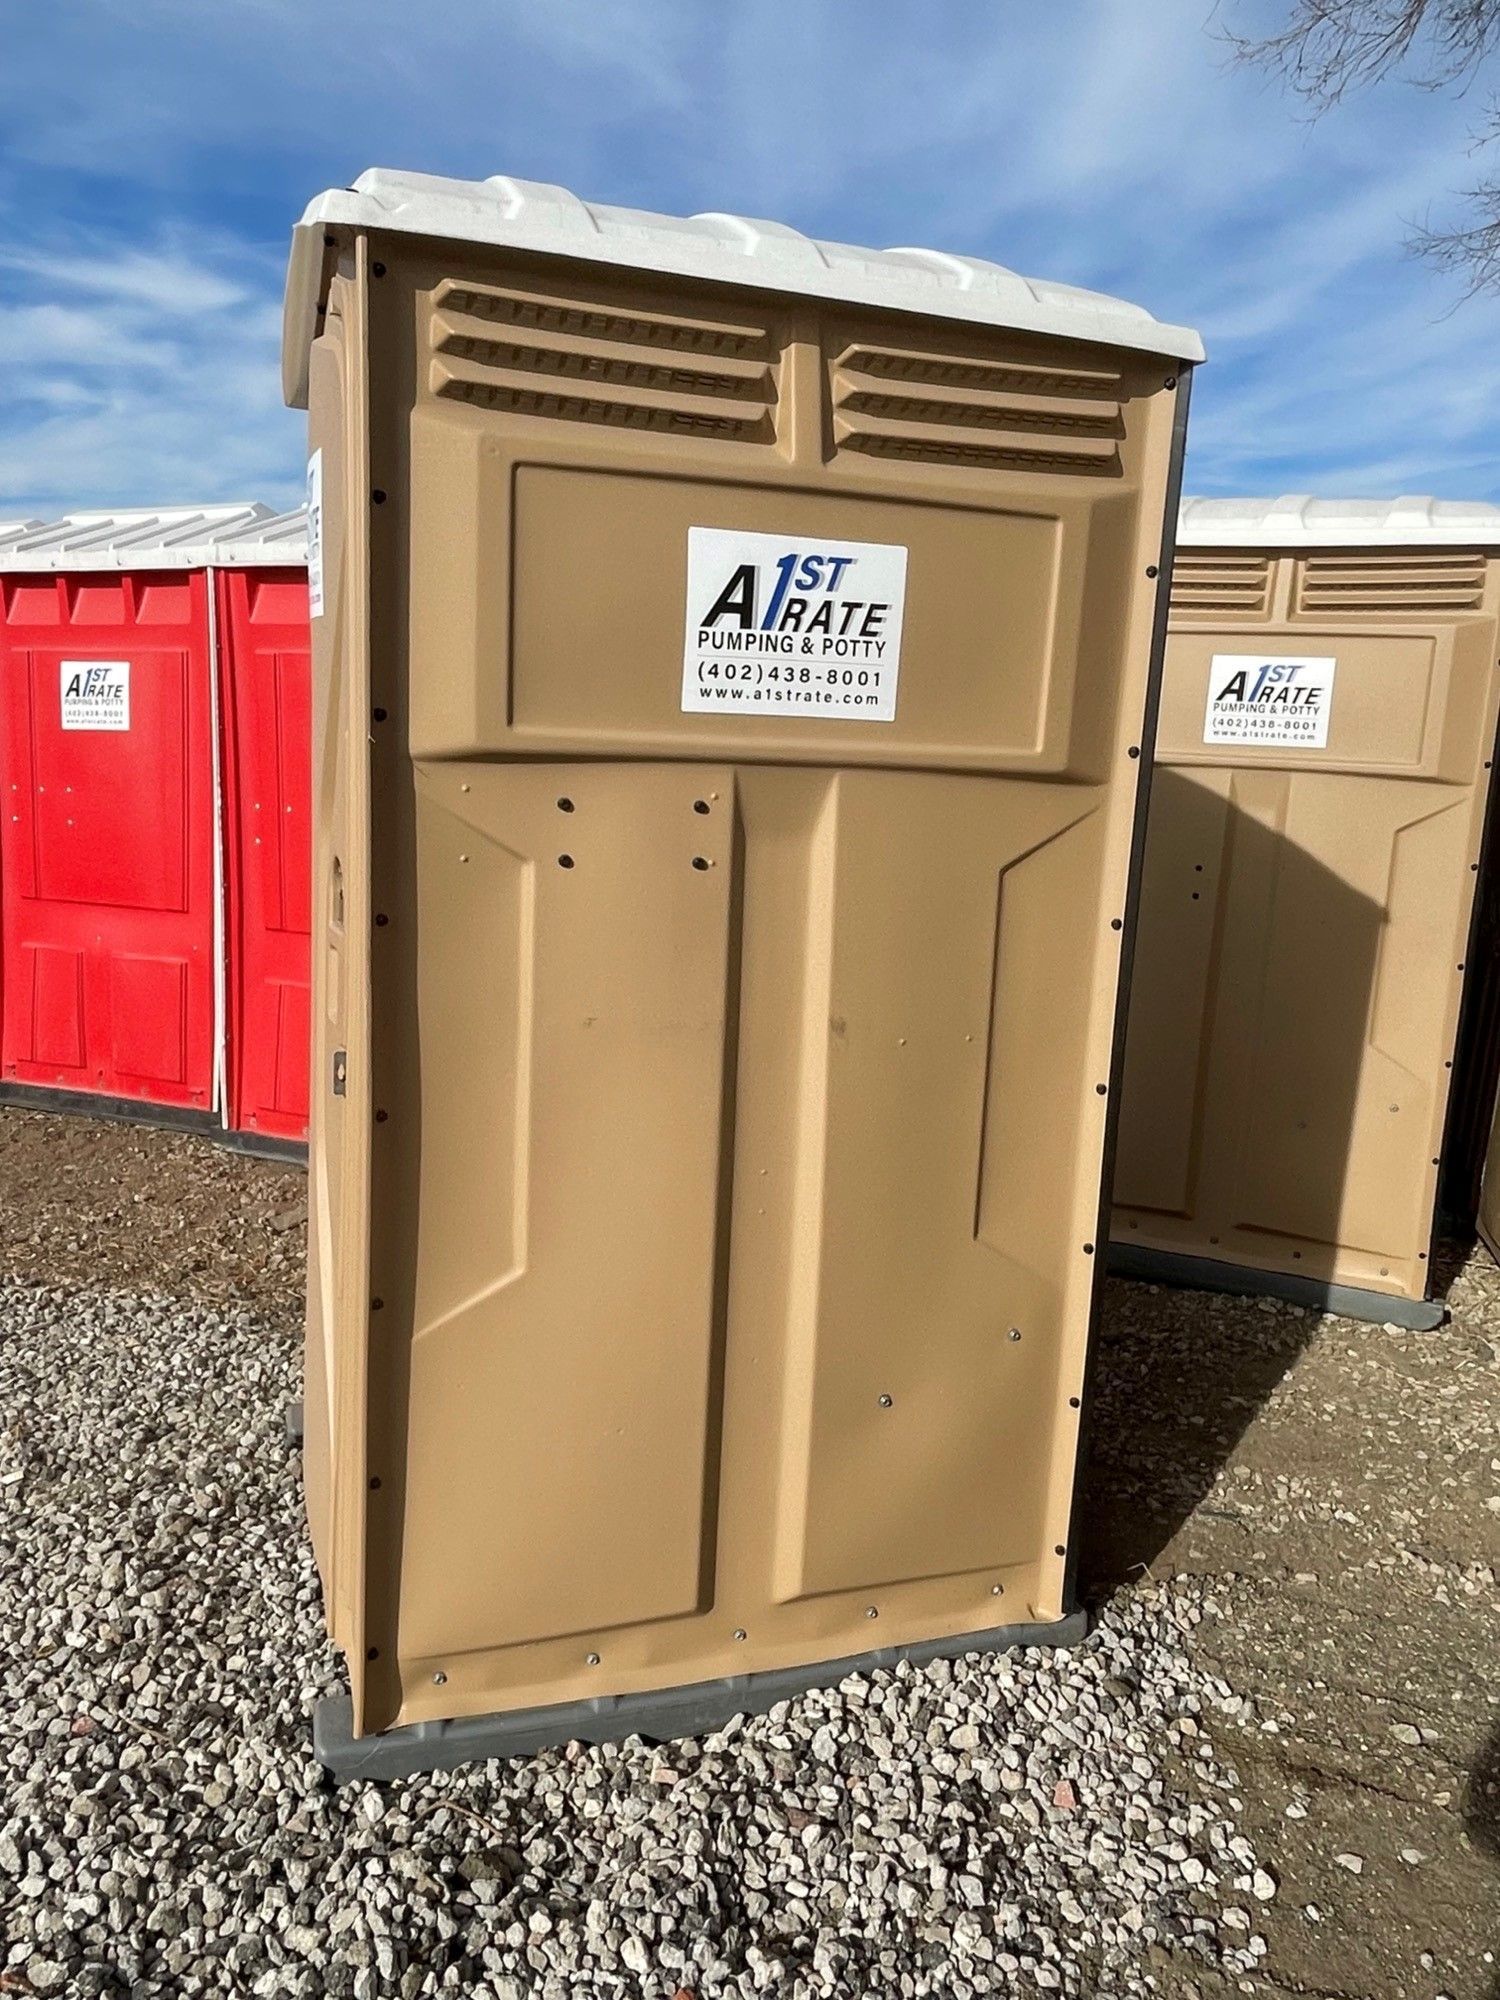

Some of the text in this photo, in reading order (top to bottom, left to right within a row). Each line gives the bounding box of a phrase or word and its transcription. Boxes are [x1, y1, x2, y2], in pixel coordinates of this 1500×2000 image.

[778, 598, 891, 637] RATE
[698, 630, 886, 658] PUMPING & POTTY
[698, 661, 880, 686] (402)438-8001
[87, 685, 124, 698] RATE
[699, 687, 878, 705] www.a1strate.com
[1257, 686, 1324, 705] RATE
[1213, 703, 1320, 716] PUMPING & POTTY
[1213, 718, 1316, 730] (402)438-8001
